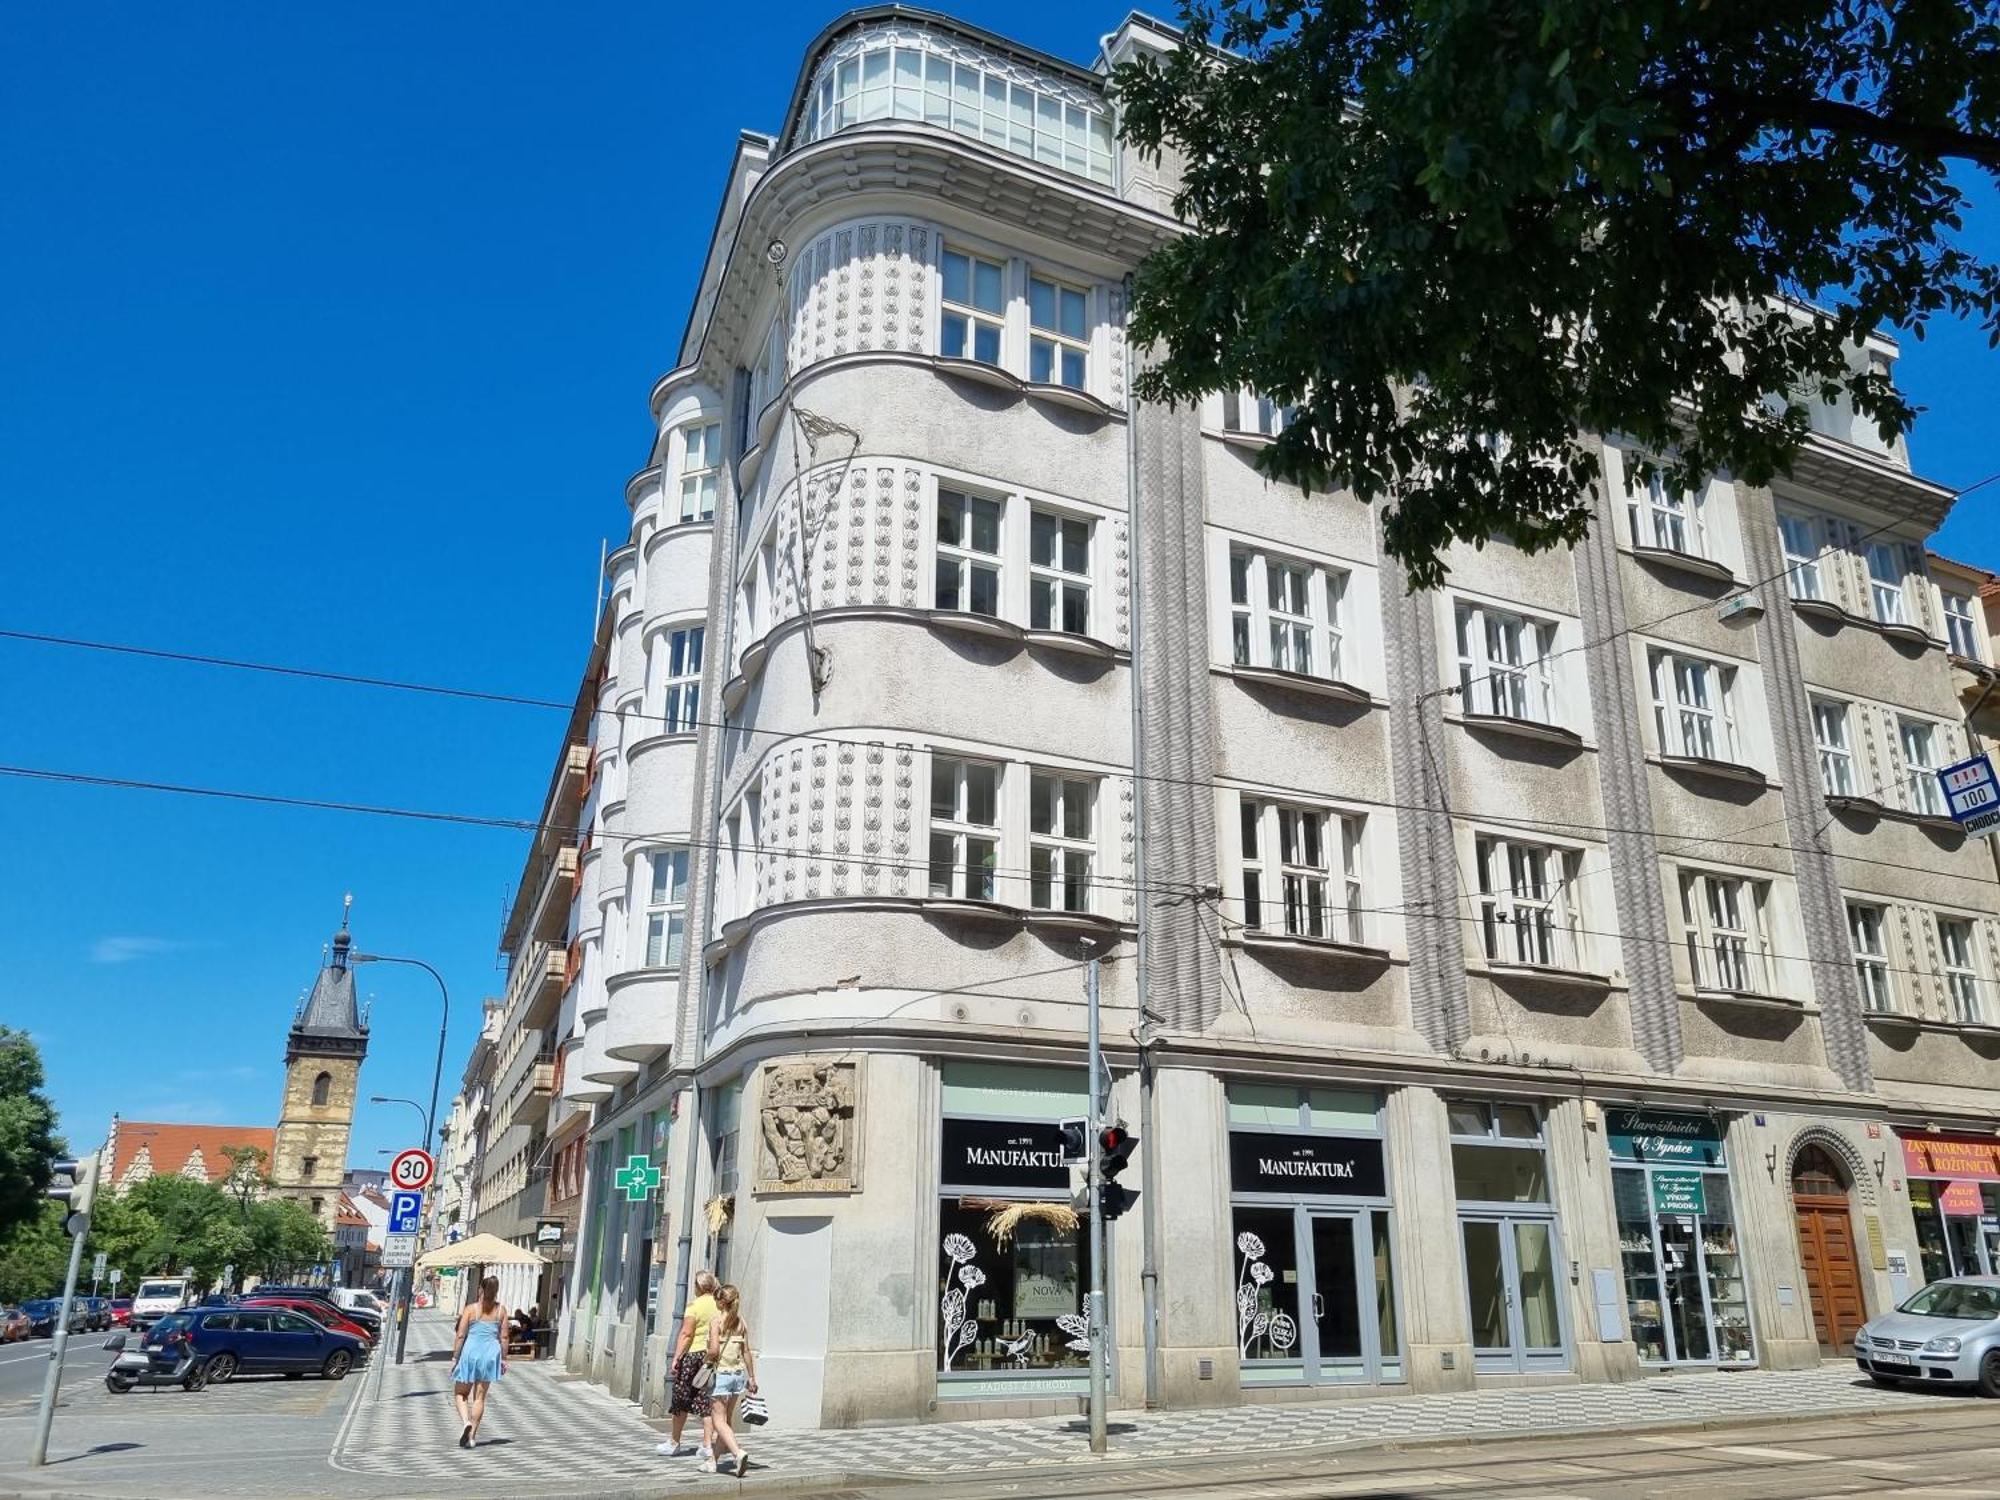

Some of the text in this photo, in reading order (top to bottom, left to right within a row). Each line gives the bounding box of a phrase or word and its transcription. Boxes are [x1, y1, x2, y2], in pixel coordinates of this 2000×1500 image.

[1962, 788, 1988, 809] 100
[966, 1147, 1069, 1168] MANUFAKTU
[399, 1160, 425, 1180] 30
[395, 1197, 415, 1221] P
